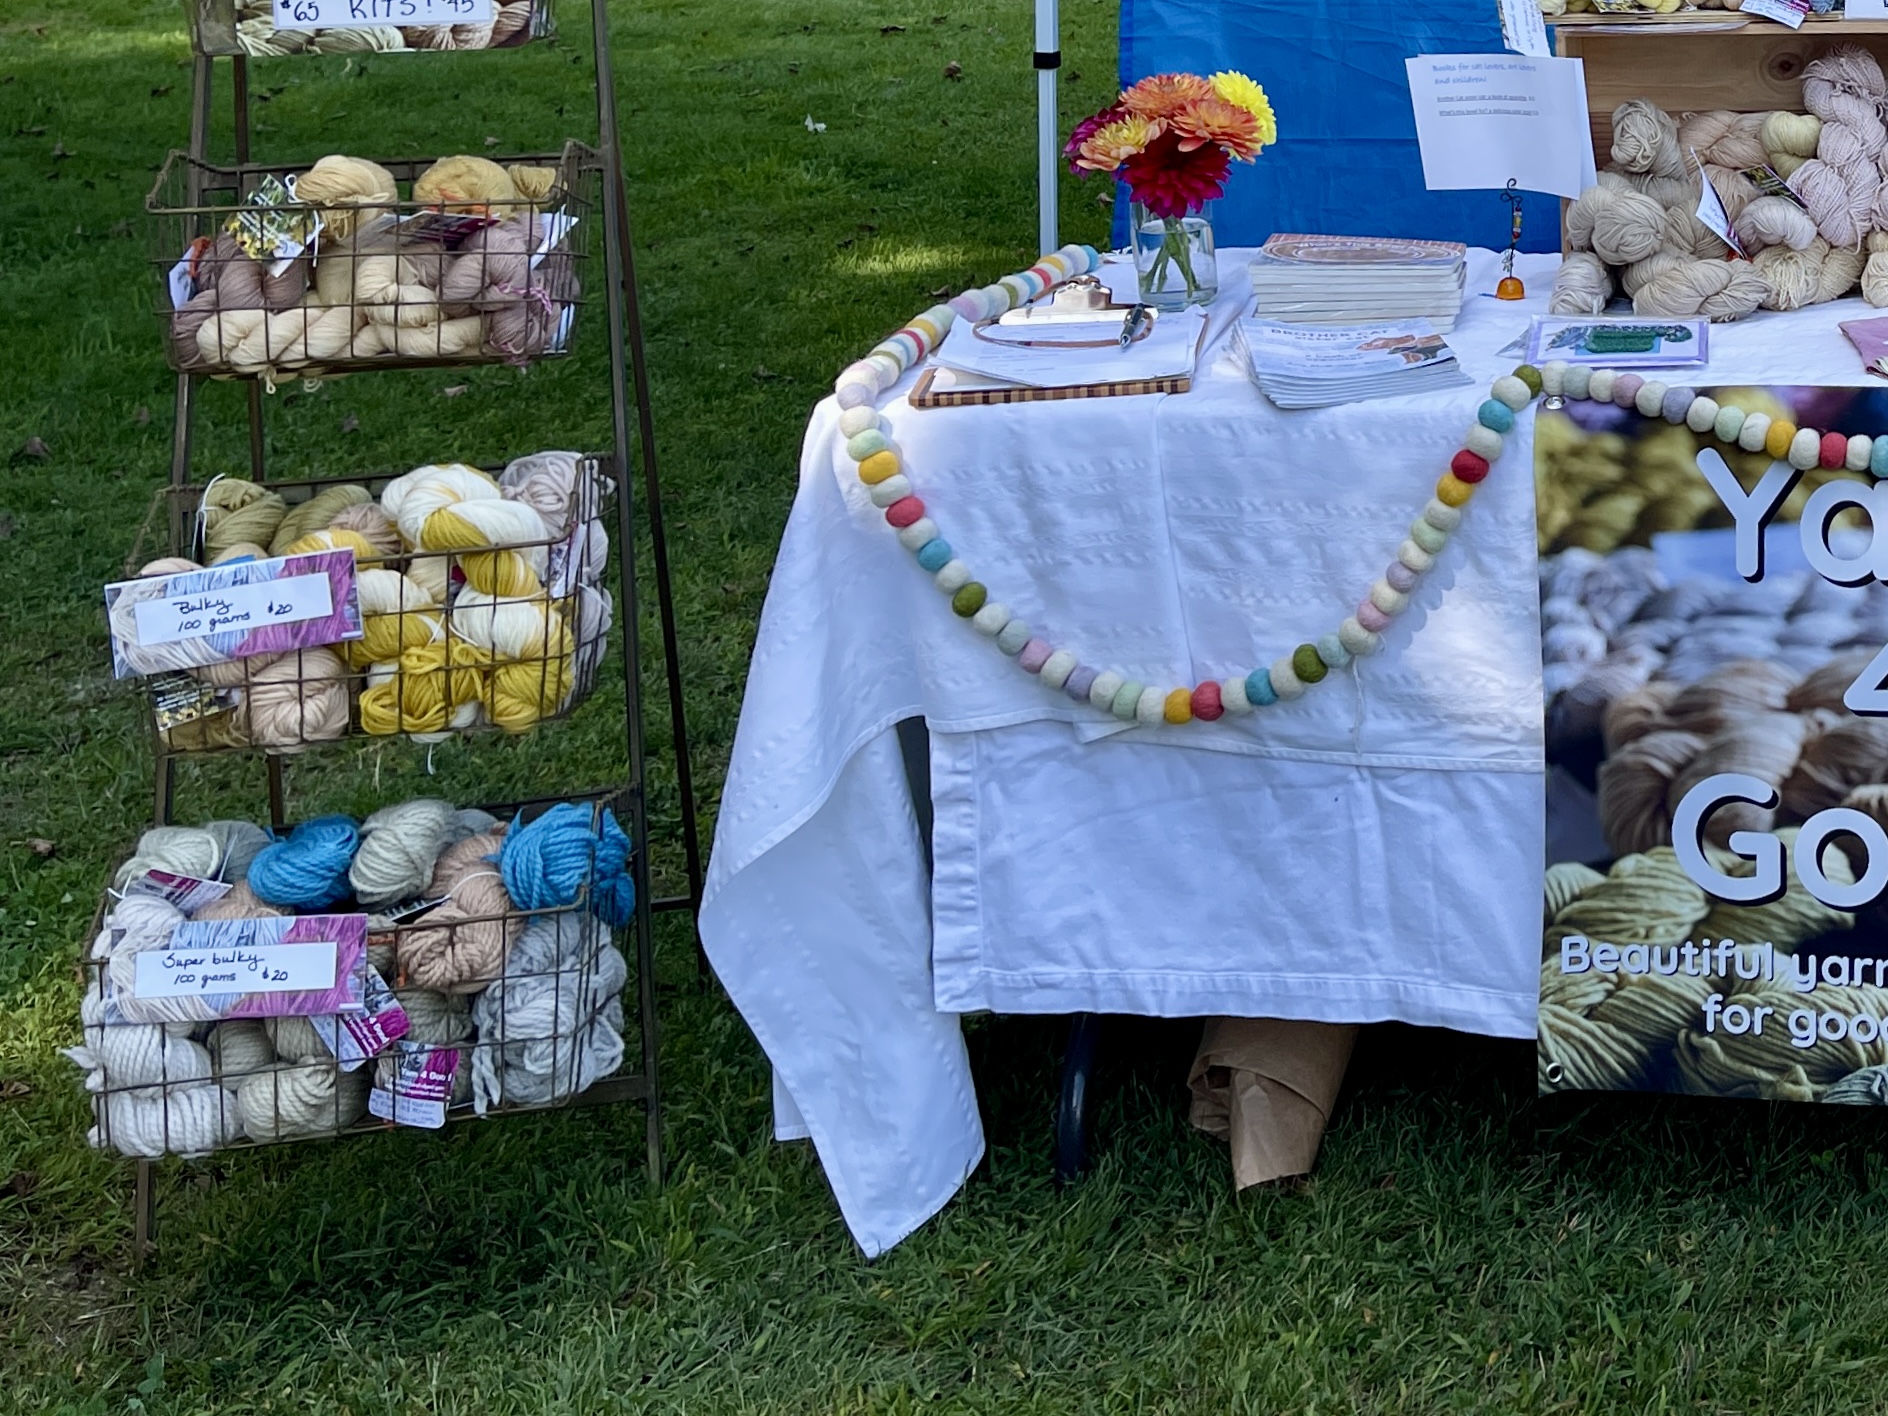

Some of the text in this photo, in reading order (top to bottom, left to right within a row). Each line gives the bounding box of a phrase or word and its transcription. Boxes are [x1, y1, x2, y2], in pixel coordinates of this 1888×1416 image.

[172, 597, 233, 616] Bulky
[177, 599, 293, 632] 100 grams $20
[162, 950, 265, 972] Super bulky
[1559, 935, 1776, 982] Beautiful
[173, 974, 196, 985] 100
[200, 972, 237, 989] grams
[1701, 993, 1775, 1037] for
